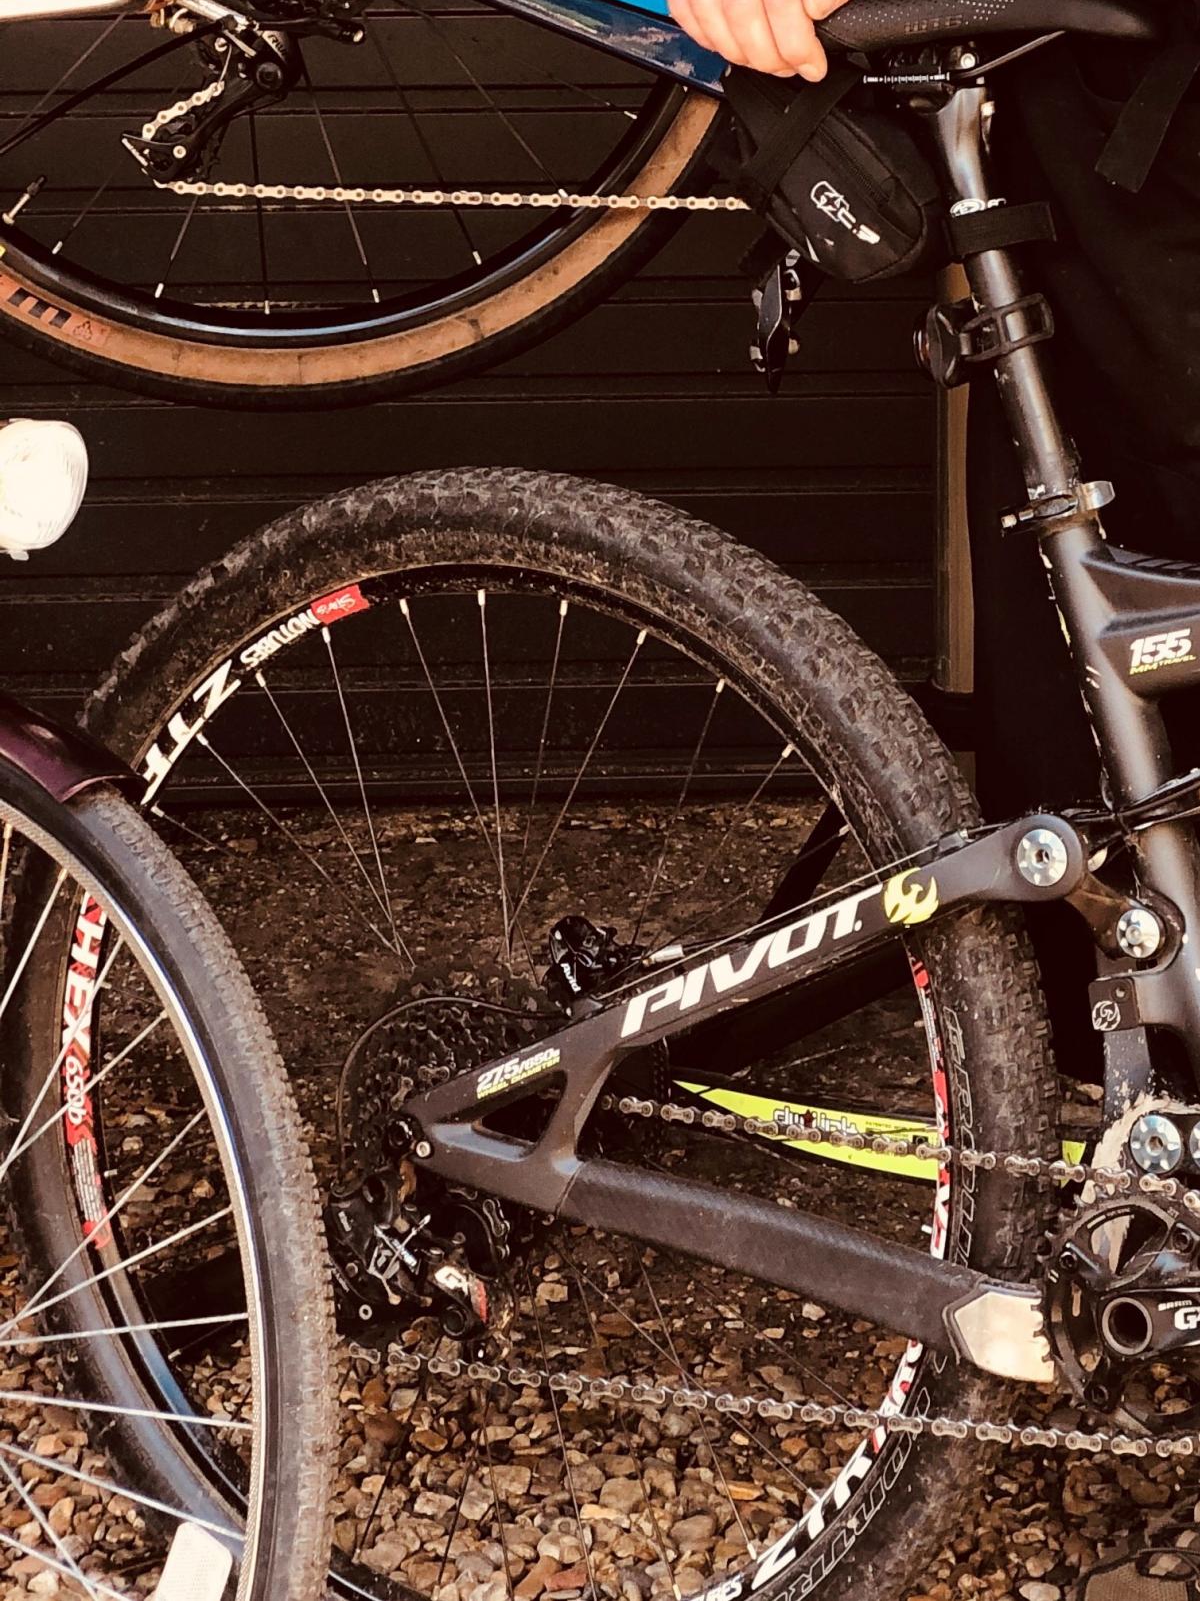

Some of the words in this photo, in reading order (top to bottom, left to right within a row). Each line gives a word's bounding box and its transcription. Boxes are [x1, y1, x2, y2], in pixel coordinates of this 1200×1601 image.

[240, 608, 322, 669] NOTUBES
[1130, 628, 1192, 668] 155
[560, 962, 582, 993] Avid
[64, 1054, 88, 1126] 650b
[1157, 1300, 1192, 1311] SRAM
[751, 1439, 873, 1591] ZTR
